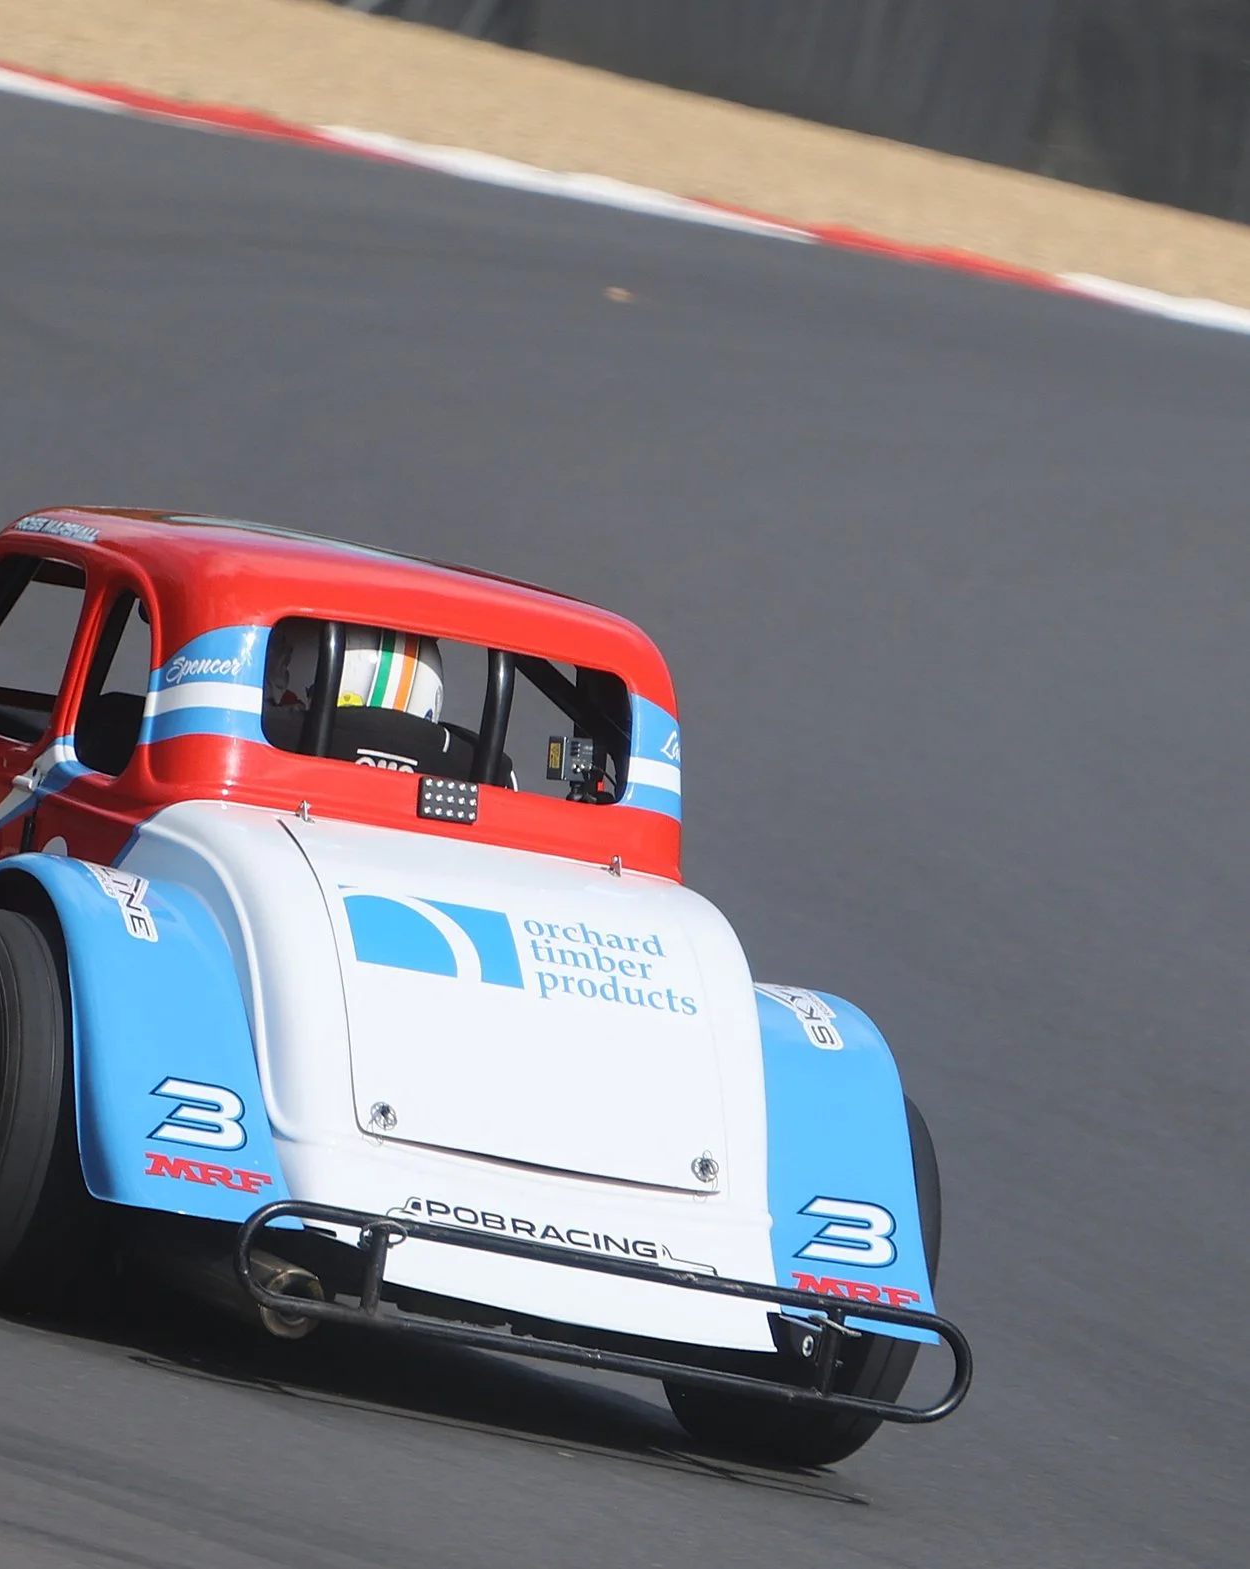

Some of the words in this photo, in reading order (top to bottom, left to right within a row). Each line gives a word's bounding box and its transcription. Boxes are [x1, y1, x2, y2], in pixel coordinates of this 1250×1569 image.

[165, 656, 240, 684] Spencer
[523, 919, 666, 957] orchard
[530, 939, 652, 980] timber
[535, 971, 698, 1016] products
[146, 1076, 247, 1151] 3
[144, 1152, 273, 1194] MRF
[426, 1199, 657, 1260] POBRACING
[792, 1195, 897, 1268] 3
